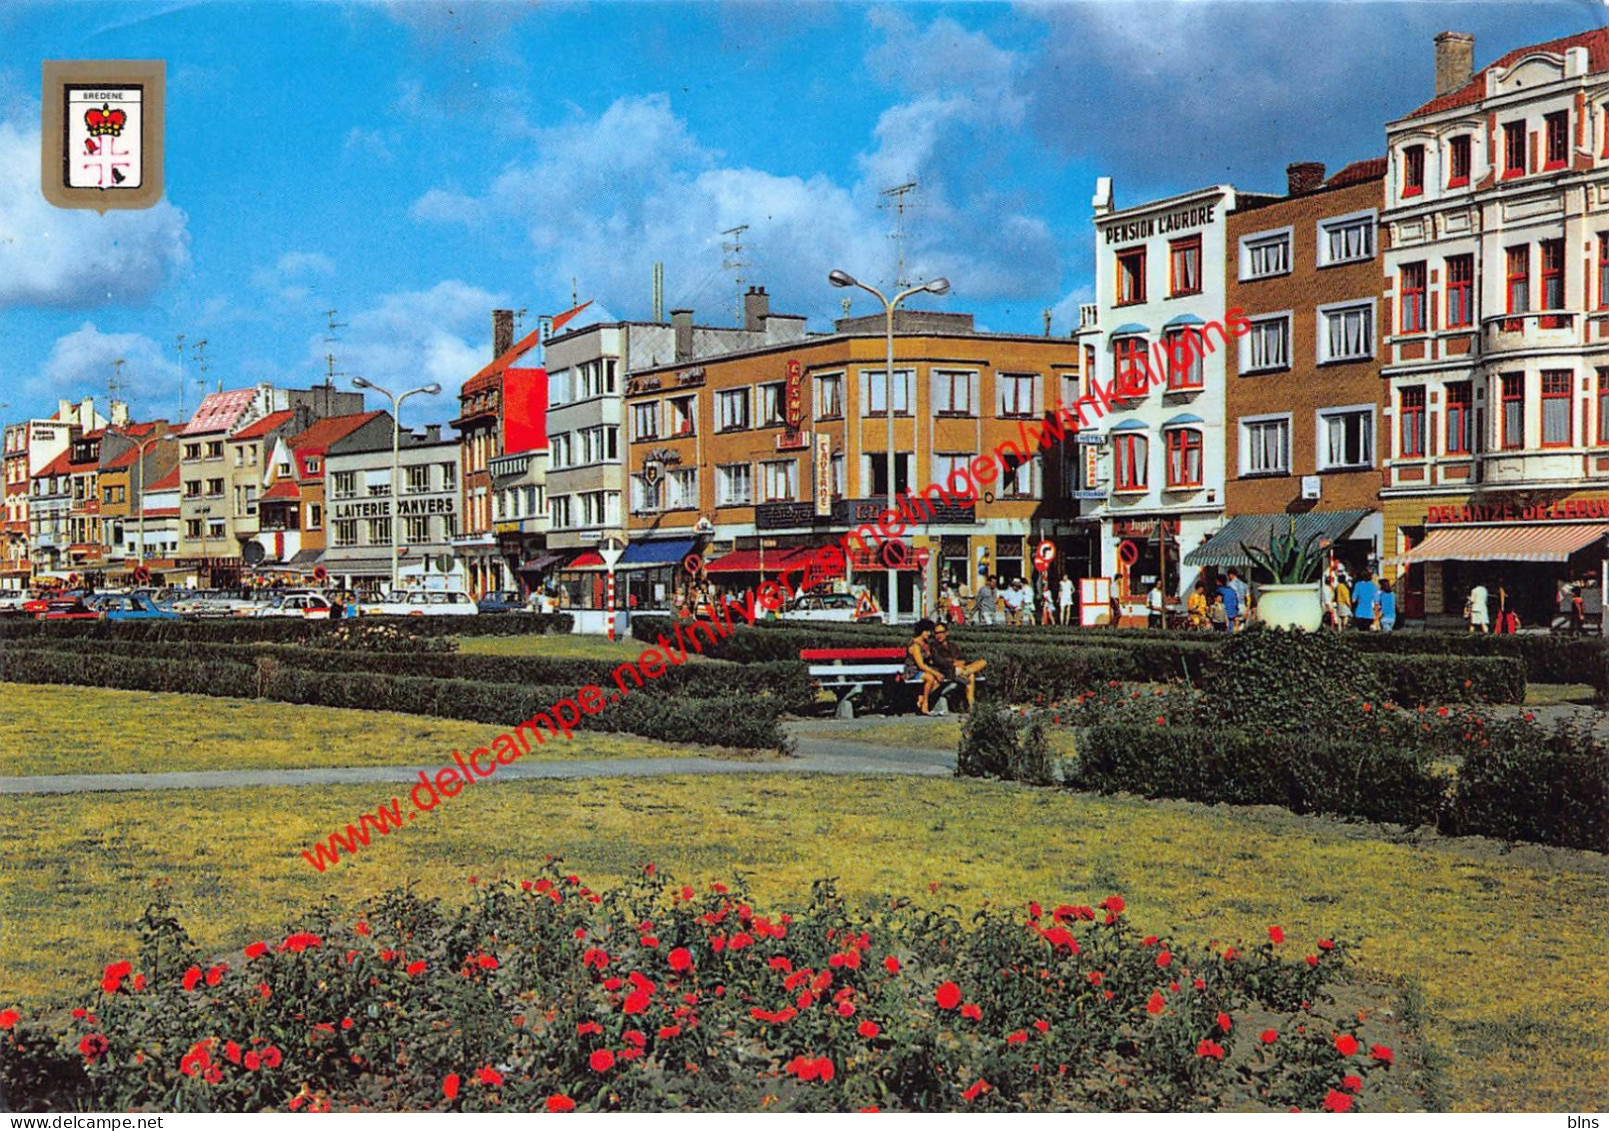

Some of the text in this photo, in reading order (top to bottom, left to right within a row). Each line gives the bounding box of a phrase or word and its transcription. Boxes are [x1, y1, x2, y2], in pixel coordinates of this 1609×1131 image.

[1105, 204, 1215, 245] PENSION L'AURORE
[336, 501, 390, 518] LAITERIE
[1522, 501, 1547, 520] DE
